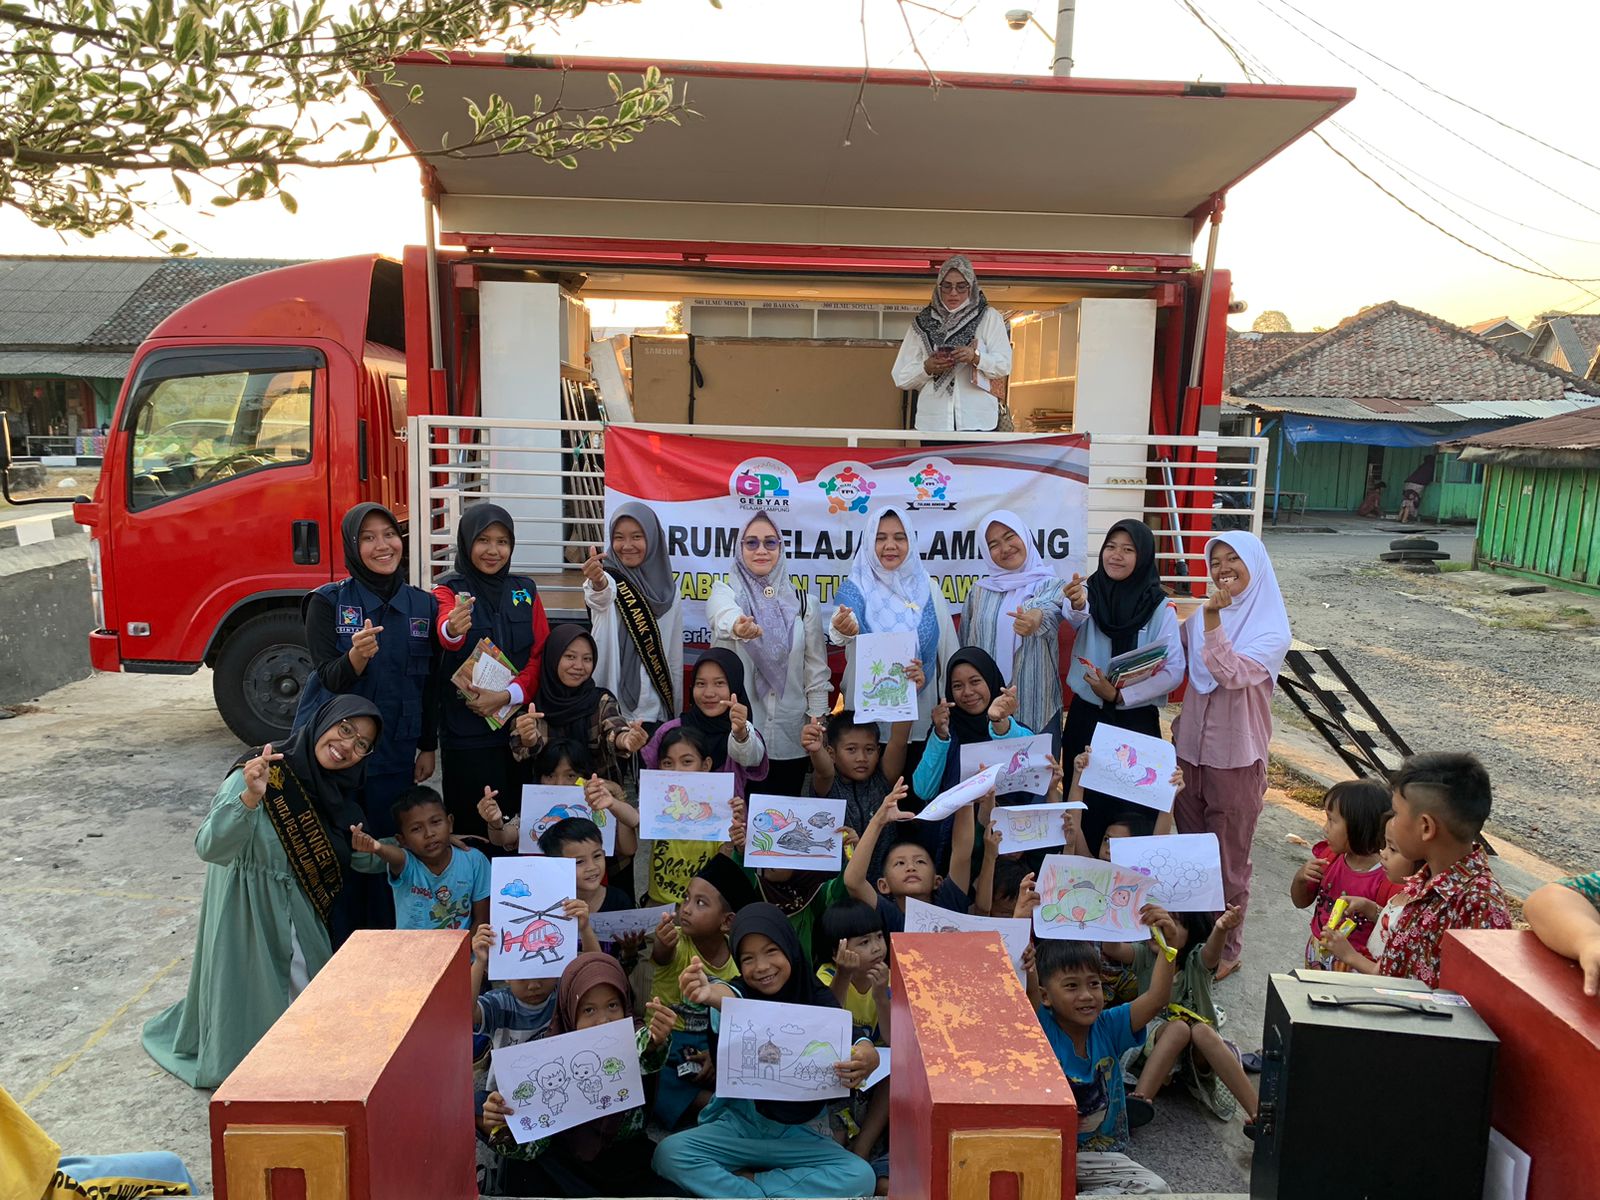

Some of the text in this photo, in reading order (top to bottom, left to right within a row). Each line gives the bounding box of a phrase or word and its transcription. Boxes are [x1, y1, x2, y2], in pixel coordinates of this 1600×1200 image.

[644, 347, 684, 356] SAMSUNG
[739, 497, 789, 506] GEBYAR
[764, 505, 790, 513] LAMPUNG
[668, 525, 740, 558] RUM
[616, 580, 637, 607] DUTA
[629, 607, 650, 636] ANAK
[643, 633, 663, 675] TULANG
[272, 795, 290, 823] DUTA
[284, 817, 309, 859] PELAJAR
[299, 851, 321, 887] LAMPUNG
[297, 809, 333, 870] RUNNER
